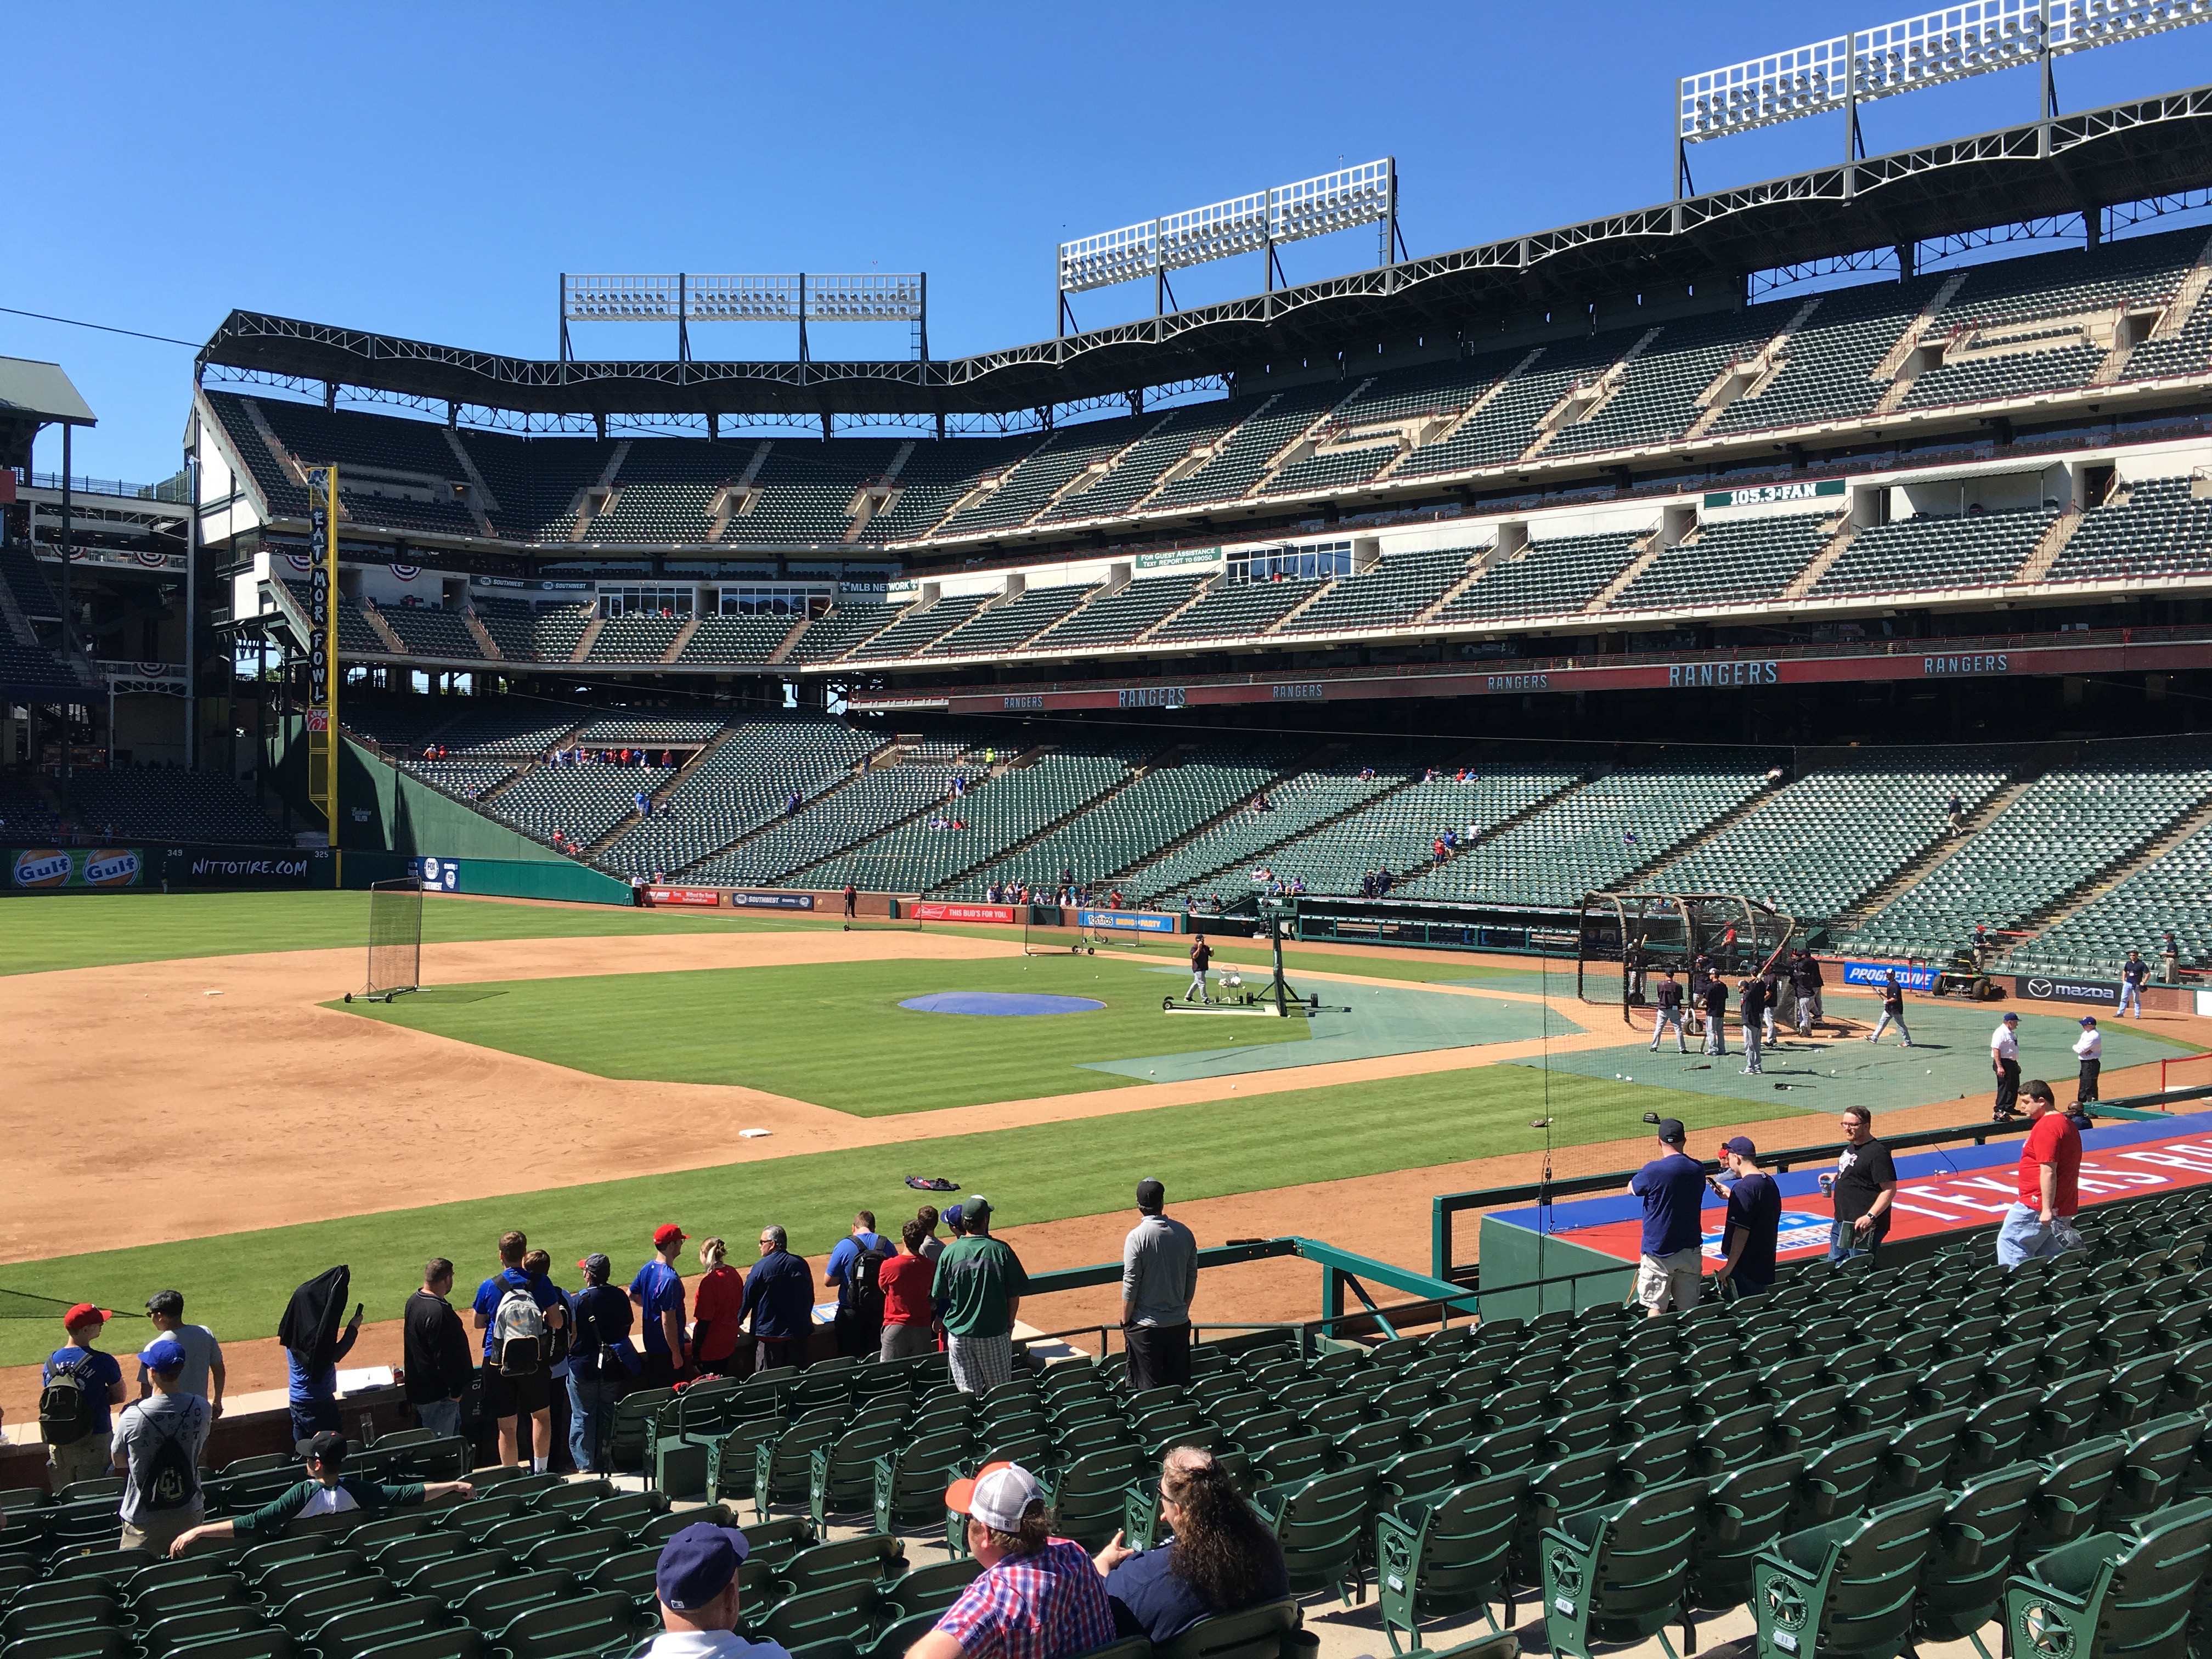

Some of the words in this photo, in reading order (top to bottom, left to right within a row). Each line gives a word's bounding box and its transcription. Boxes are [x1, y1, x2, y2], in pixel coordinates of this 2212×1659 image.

[1730, 488, 1776, 505] 105.3
[1781, 483, 1816, 500] FAN
[313, 511, 325, 561] EAT
[1177, 548, 1216, 557] ASSISTANCE
[493, 579, 524, 588] SOUTHWEST
[851, 583, 871, 591] MLB
[873, 581, 910, 591] NETWORK
[314, 572, 326, 622] MOR
[312, 633, 325, 701] FOWL
[1925, 654, 2007, 673] RANGERS
[1488, 675, 1548, 690] RANGERS
[1669, 662, 1778, 686] RANGERS
[1119, 688, 1186, 707] RANGERS
[1273, 685, 1322, 698] RANGERS
[1004, 696, 1042, 708] RANGERS
[19, 858, 69, 880] Gulf
[87, 857, 134, 879] Gulf
[192, 857, 307, 877] NITTOTIRE.COM
[427, 861, 436, 871] FOX
[1849, 968, 1933, 985] PROGESSIVE
[2056, 985, 2114, 999] mazda
[1561, 1601, 1568, 1610] 10
[1781, 1635, 1788, 1644] 11
